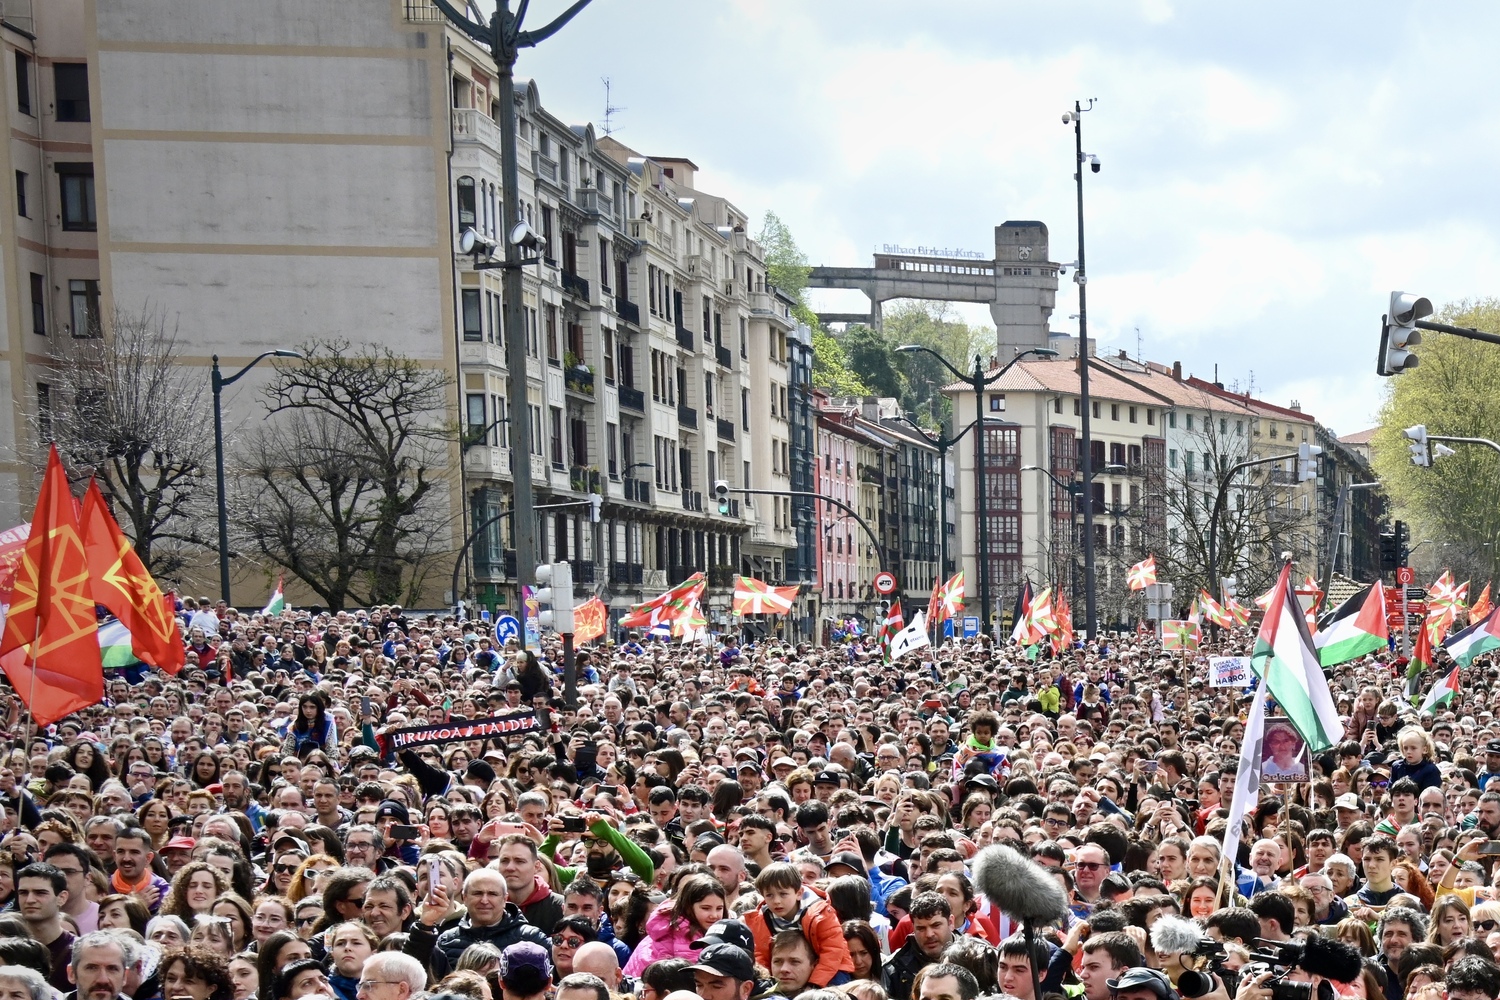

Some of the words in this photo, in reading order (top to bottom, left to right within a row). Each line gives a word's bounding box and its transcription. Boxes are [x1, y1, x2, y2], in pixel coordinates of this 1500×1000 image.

[1215, 673, 1247, 685] HARRO!
[392, 727, 463, 748] HIRUKOA
[478, 714, 542, 735] TALDEA
